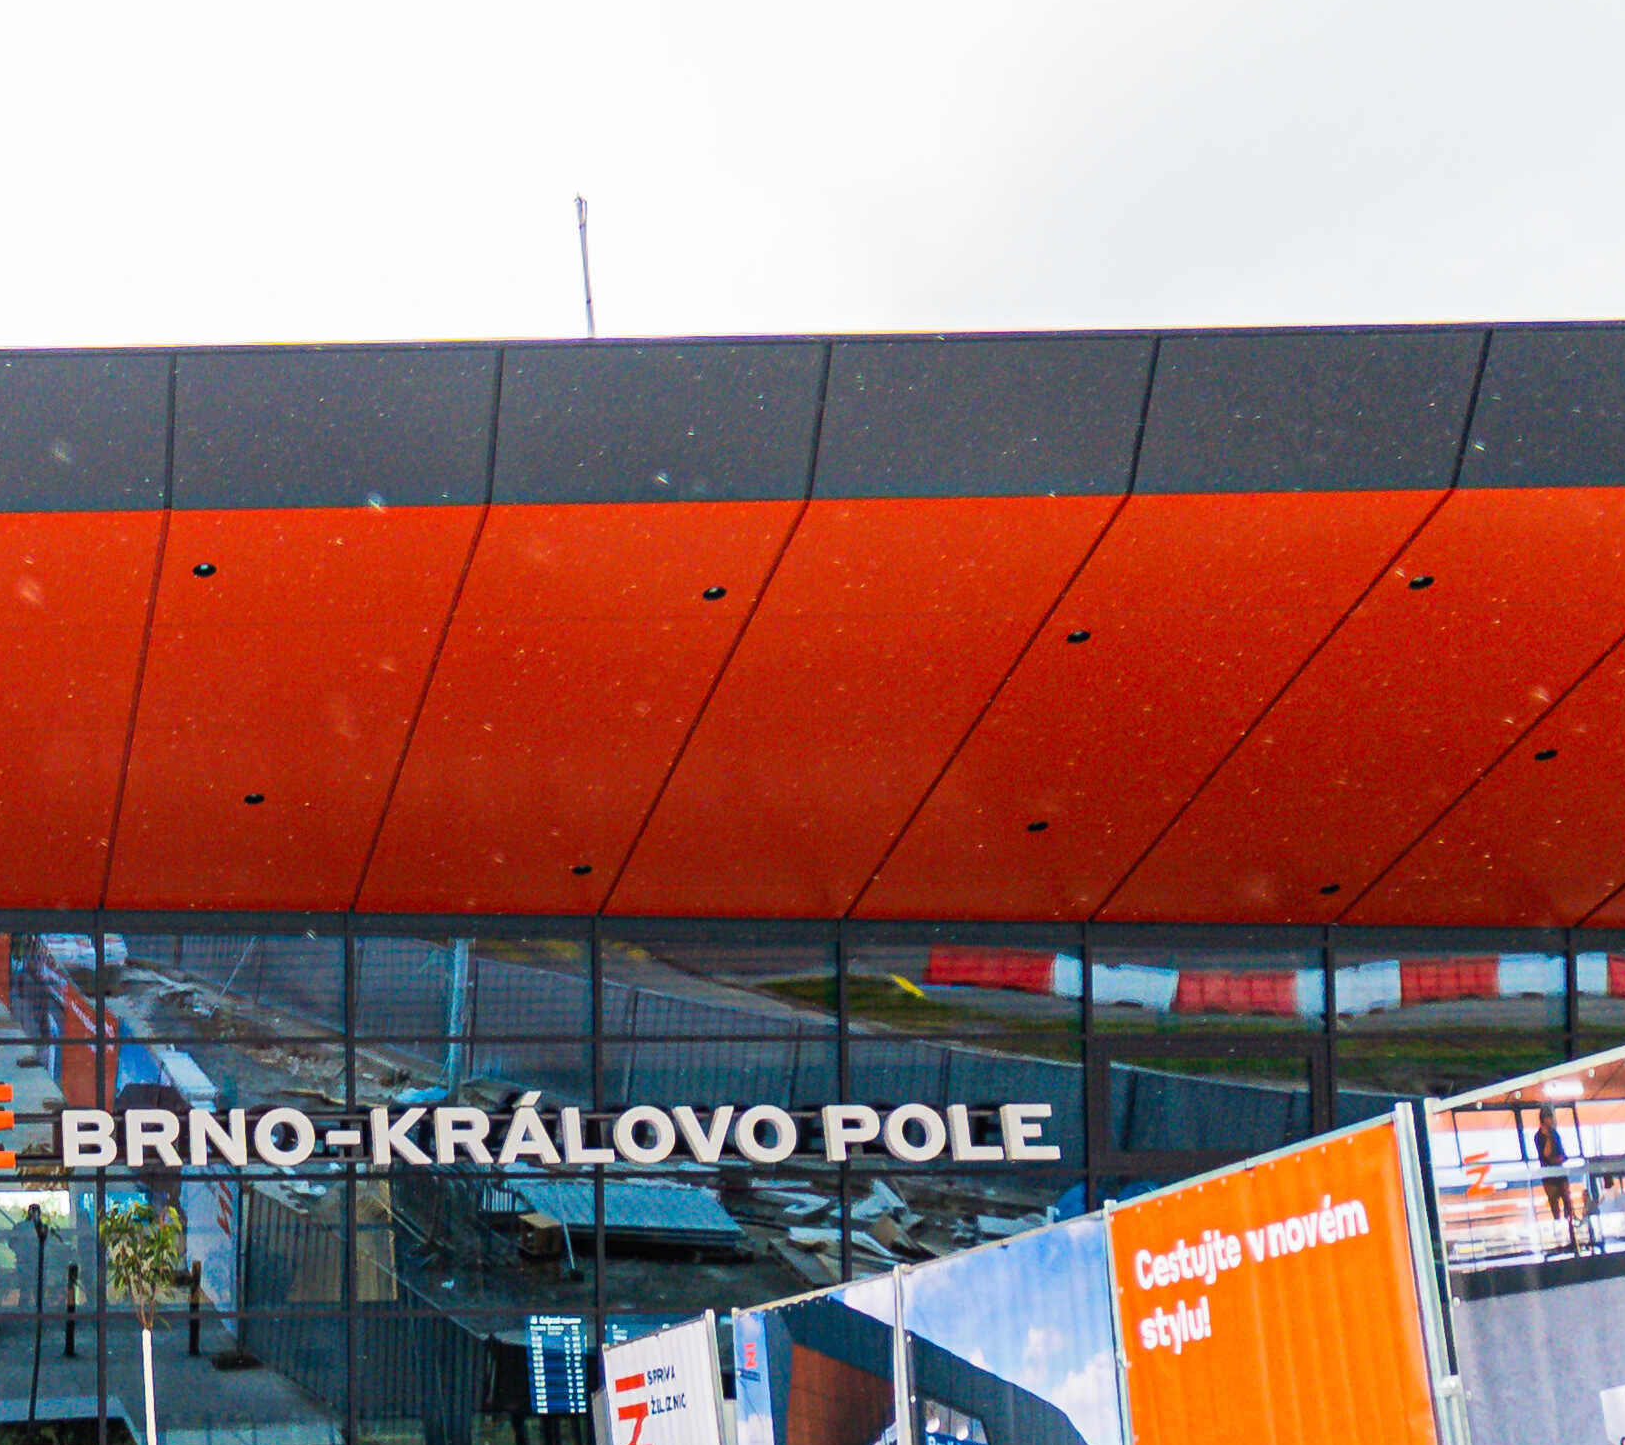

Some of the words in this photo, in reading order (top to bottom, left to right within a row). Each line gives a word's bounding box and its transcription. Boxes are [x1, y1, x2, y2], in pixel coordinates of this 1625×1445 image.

[61, 1090, 797, 1167] BRNO-KRÁLOVO
[821, 1102, 1062, 1163] POLE
[1135, 1228, 1242, 1290] Cestujte
[1245, 1228, 1266, 1262] v
[1266, 1193, 1370, 1258] novém
[1139, 1295, 1213, 1355] stylu!
